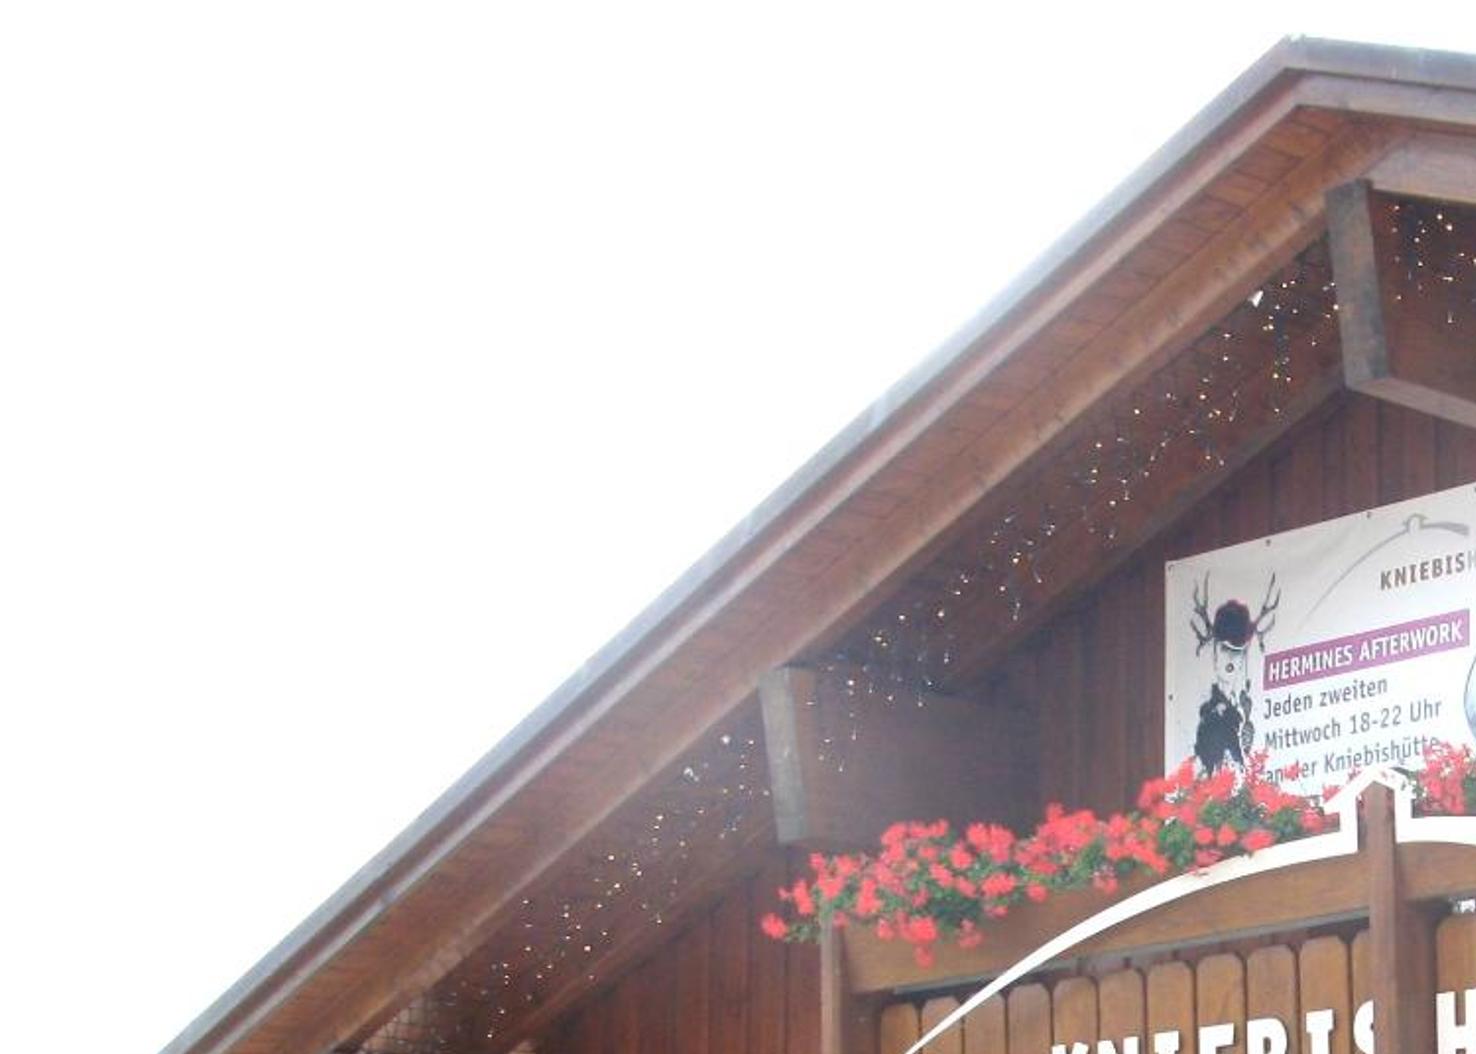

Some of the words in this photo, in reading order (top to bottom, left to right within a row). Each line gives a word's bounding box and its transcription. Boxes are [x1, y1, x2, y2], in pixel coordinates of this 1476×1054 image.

[1268, 645, 1353, 682] HERMINES
[1359, 620, 1464, 662] AFTERWORK
[1264, 694, 1313, 720] Jeden
[1319, 678, 1388, 708] zweiten
[1265, 717, 1341, 751] Mittwoch
[1350, 704, 1402, 735] 18-22
[1410, 698, 1442, 723] Uhr
